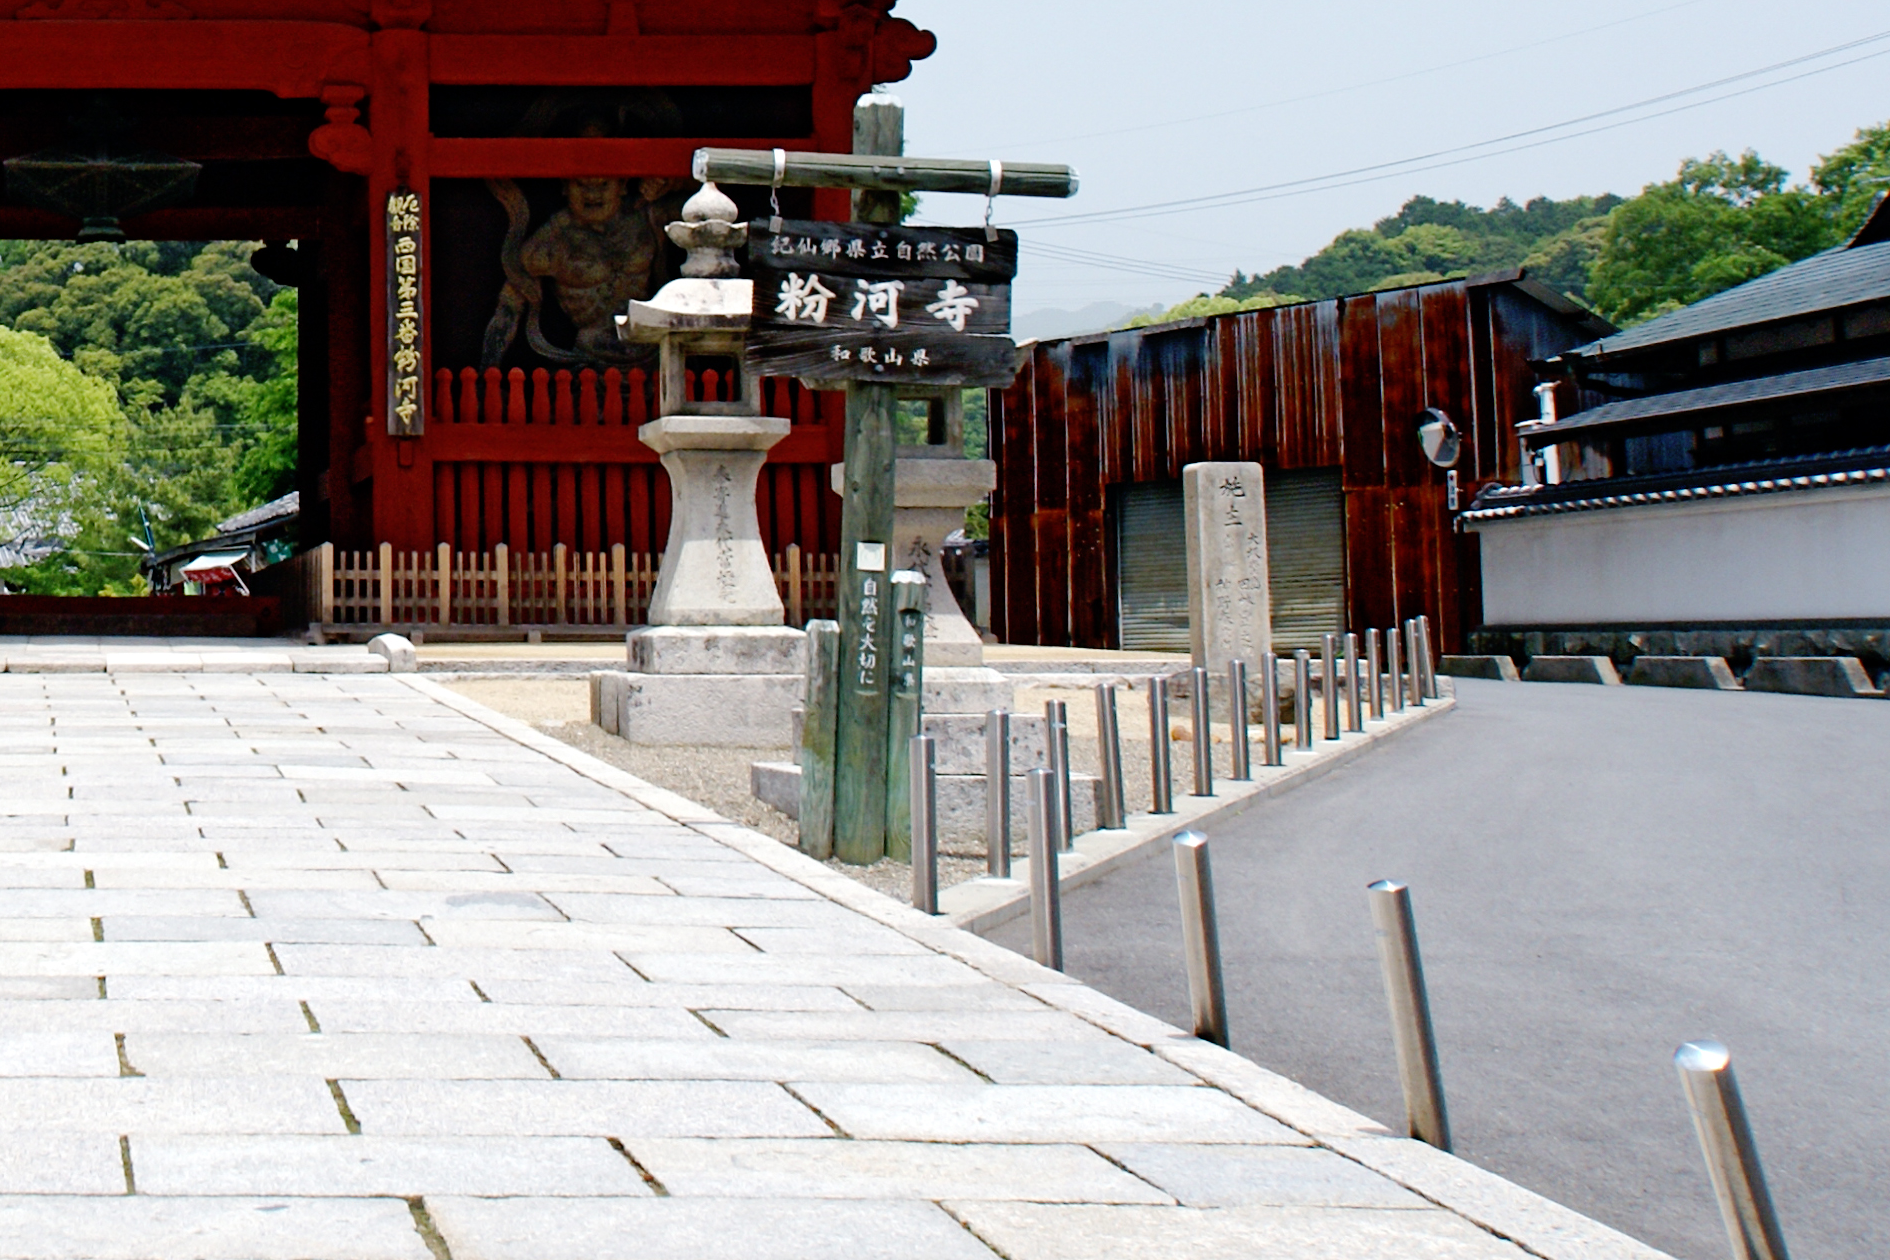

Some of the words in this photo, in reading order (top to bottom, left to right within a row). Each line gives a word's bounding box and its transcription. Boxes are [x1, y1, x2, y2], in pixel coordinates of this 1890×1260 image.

[775, 271, 980, 332] 粉河寺
[830, 343, 930, 366] 和歌山県
[858, 577, 878, 684] 自然を大切に
